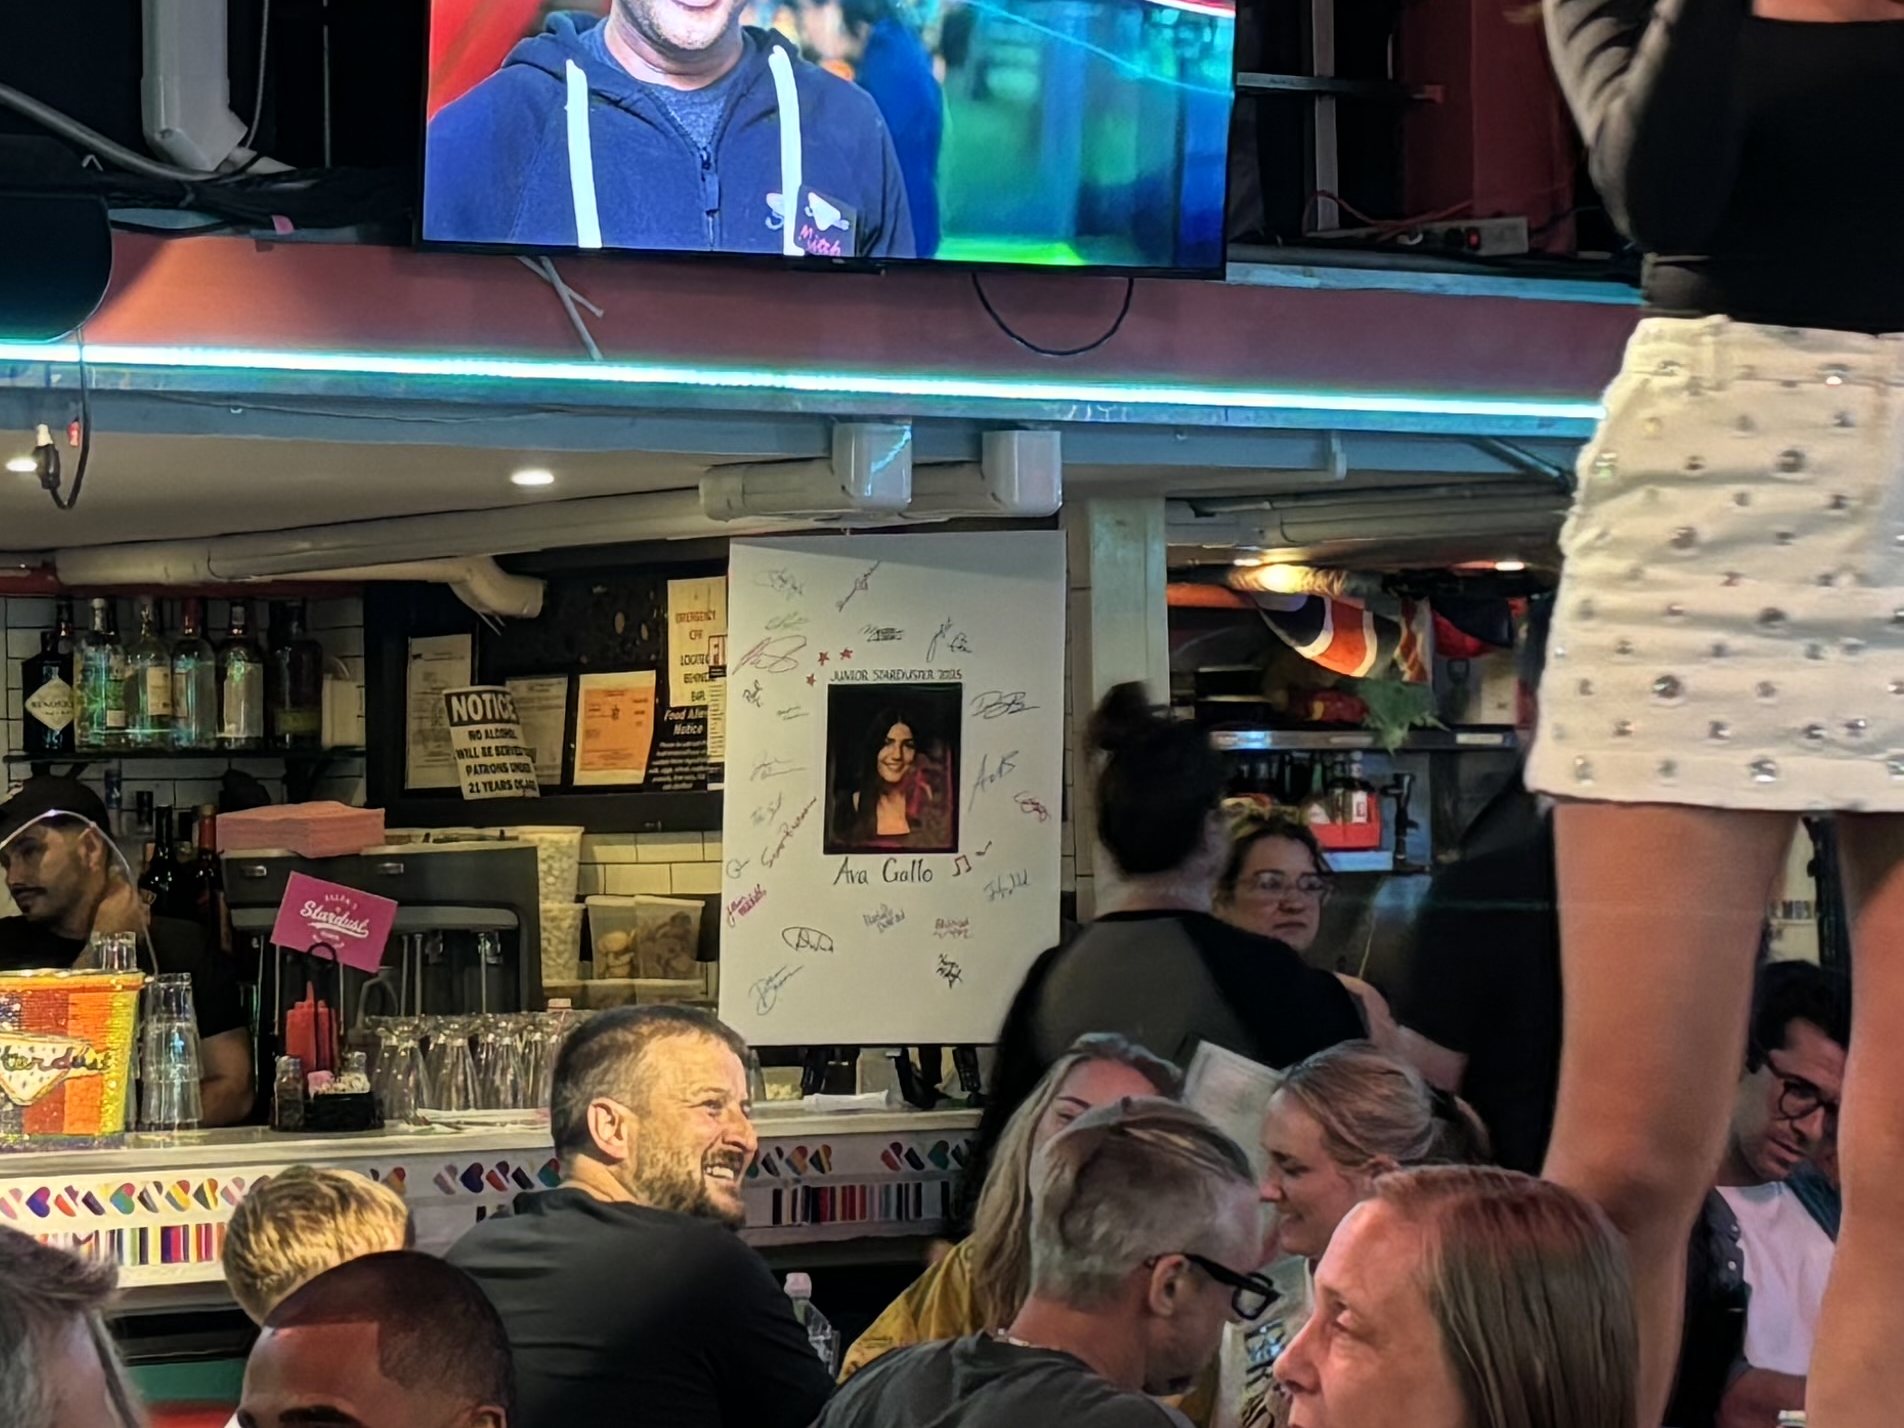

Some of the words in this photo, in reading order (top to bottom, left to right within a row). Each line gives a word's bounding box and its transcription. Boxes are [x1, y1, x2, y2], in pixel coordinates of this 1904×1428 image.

[830, 669, 869, 682] JUNIOR
[451, 693, 518, 722] NOTICE
[468, 729, 483, 741] NO
[455, 747, 480, 760] WILL
[466, 762, 509, 776] PATRONS
[468, 782, 481, 794] 21
[482, 780, 514, 792] YEARS
[833, 856, 869, 886] Ava
[882, 856, 934, 884] Gallo
[300, 900, 370, 936] Stardust
